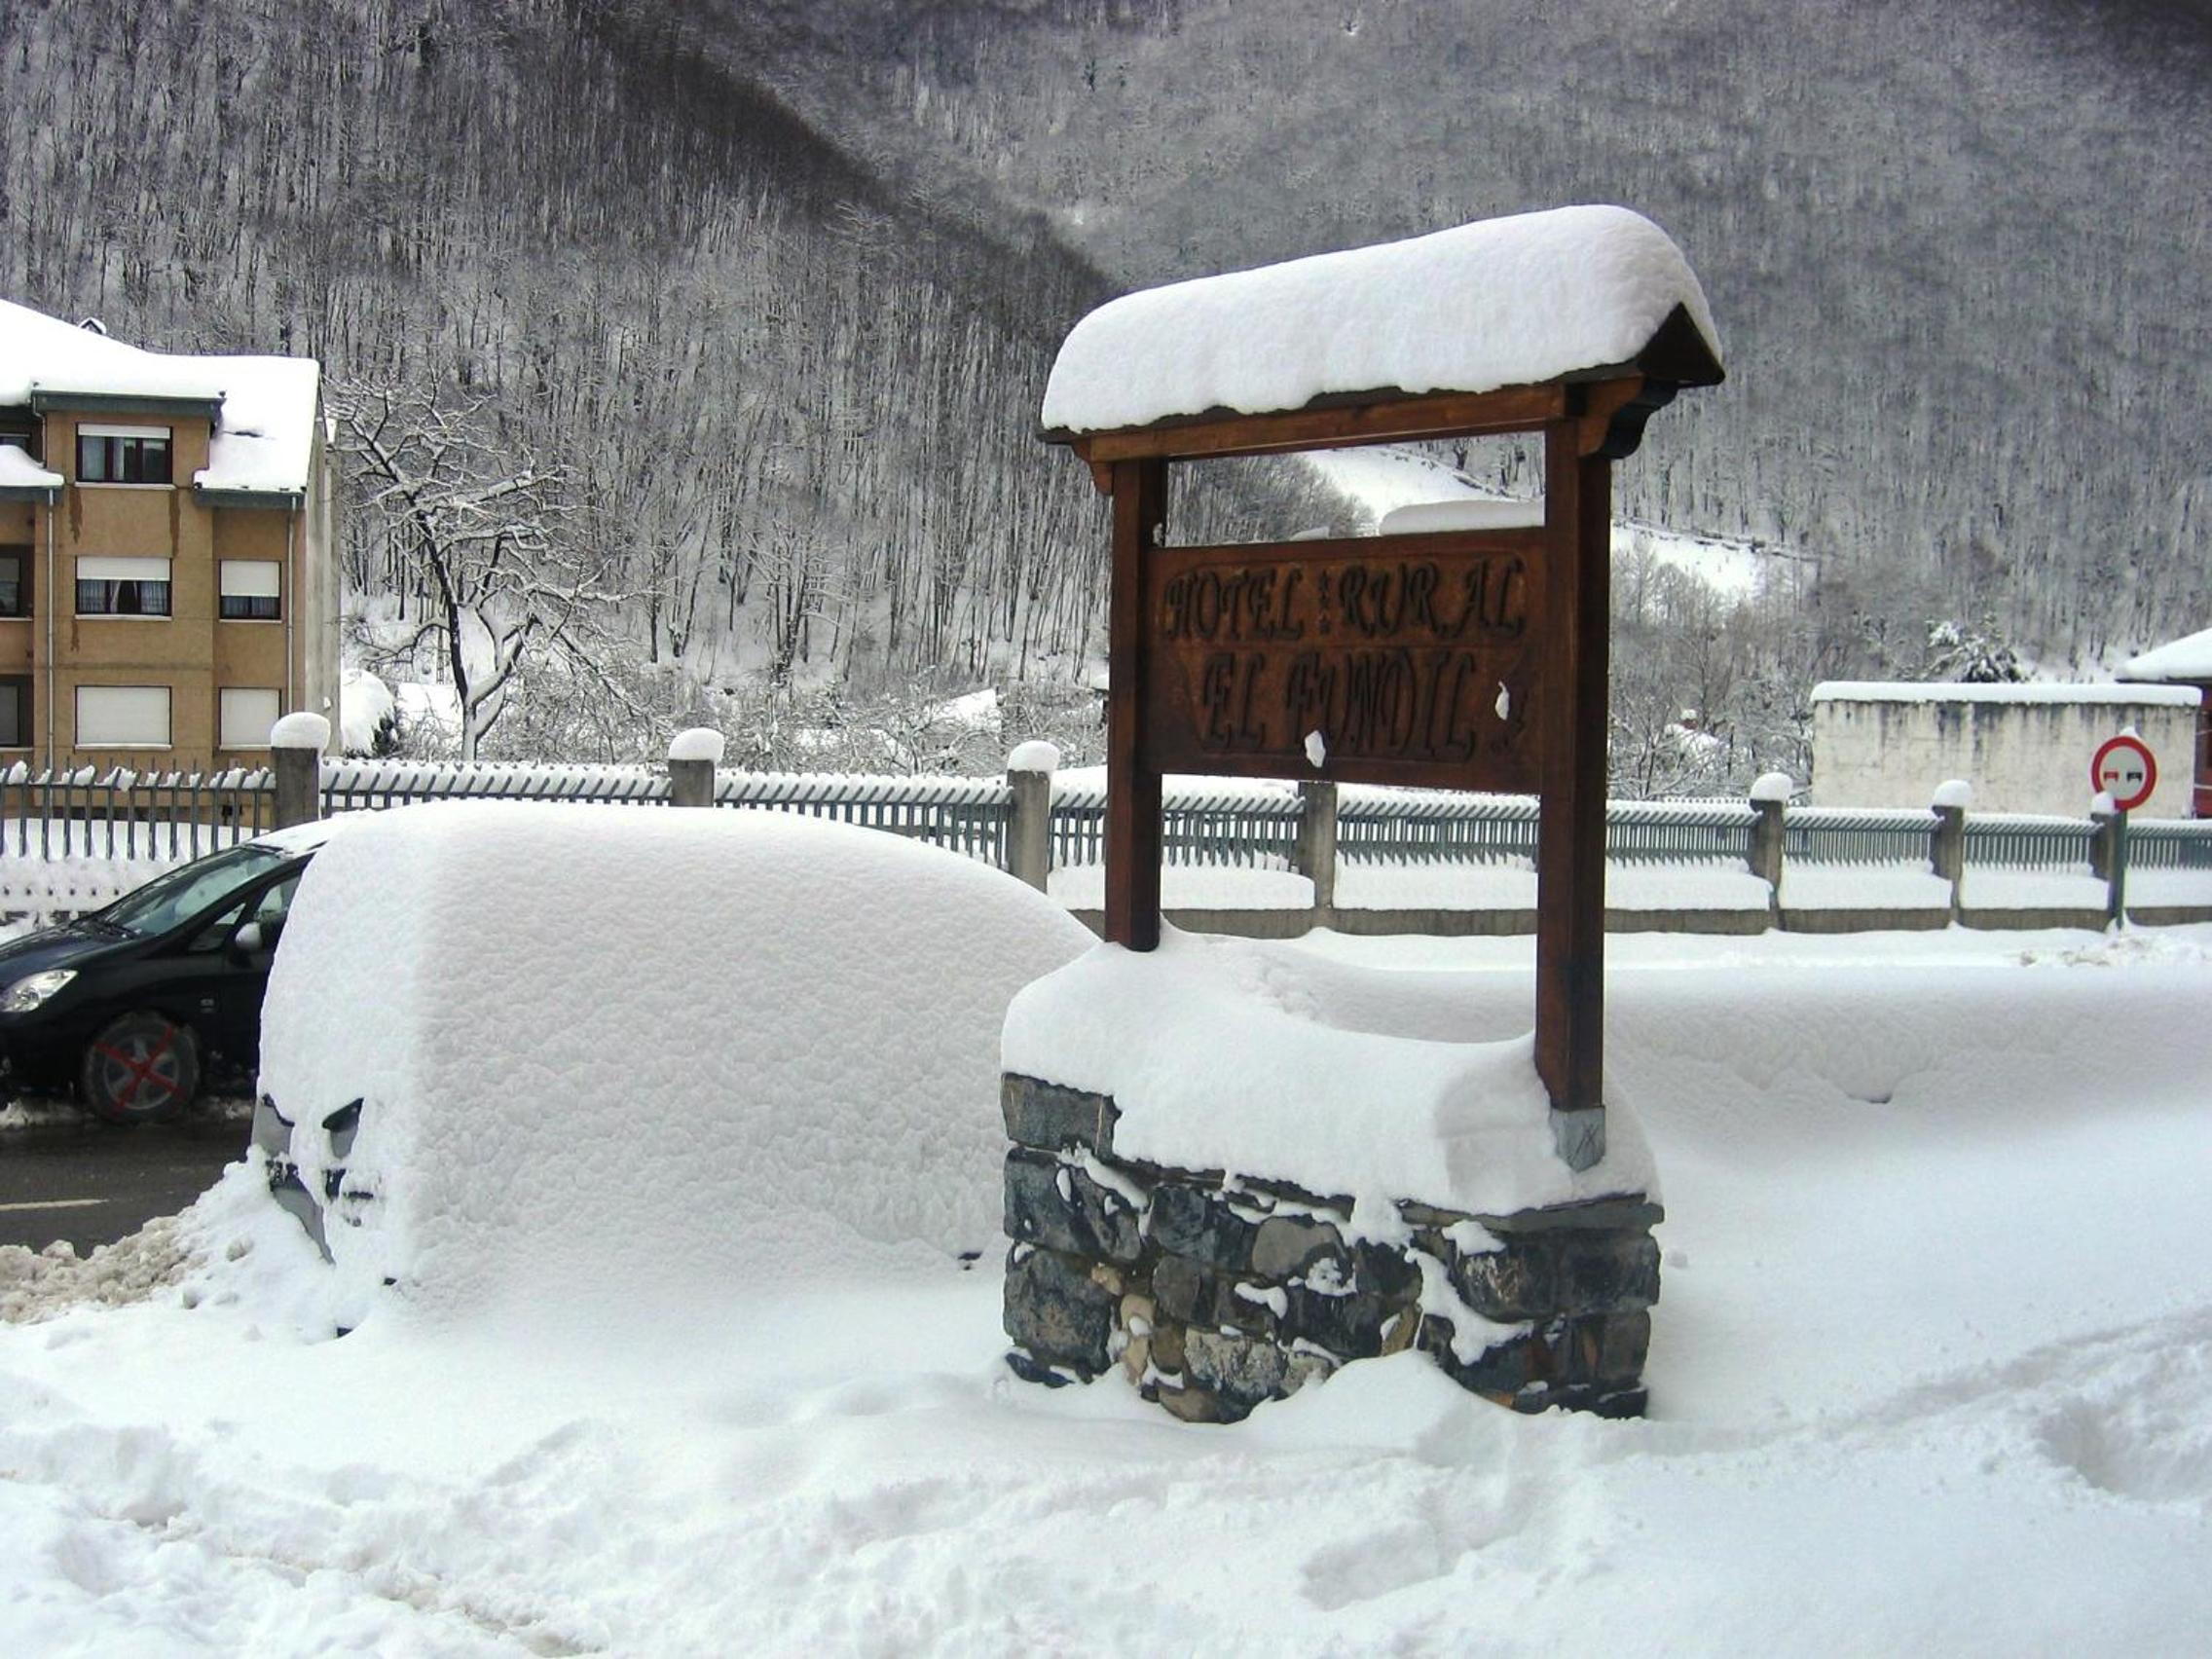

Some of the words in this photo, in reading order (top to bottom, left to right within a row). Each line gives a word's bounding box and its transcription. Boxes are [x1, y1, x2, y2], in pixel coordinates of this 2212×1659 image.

[1165, 569, 1305, 640] HOTEL
[1340, 556, 1527, 640] RURAL
[1202, 651, 1266, 751] EL
